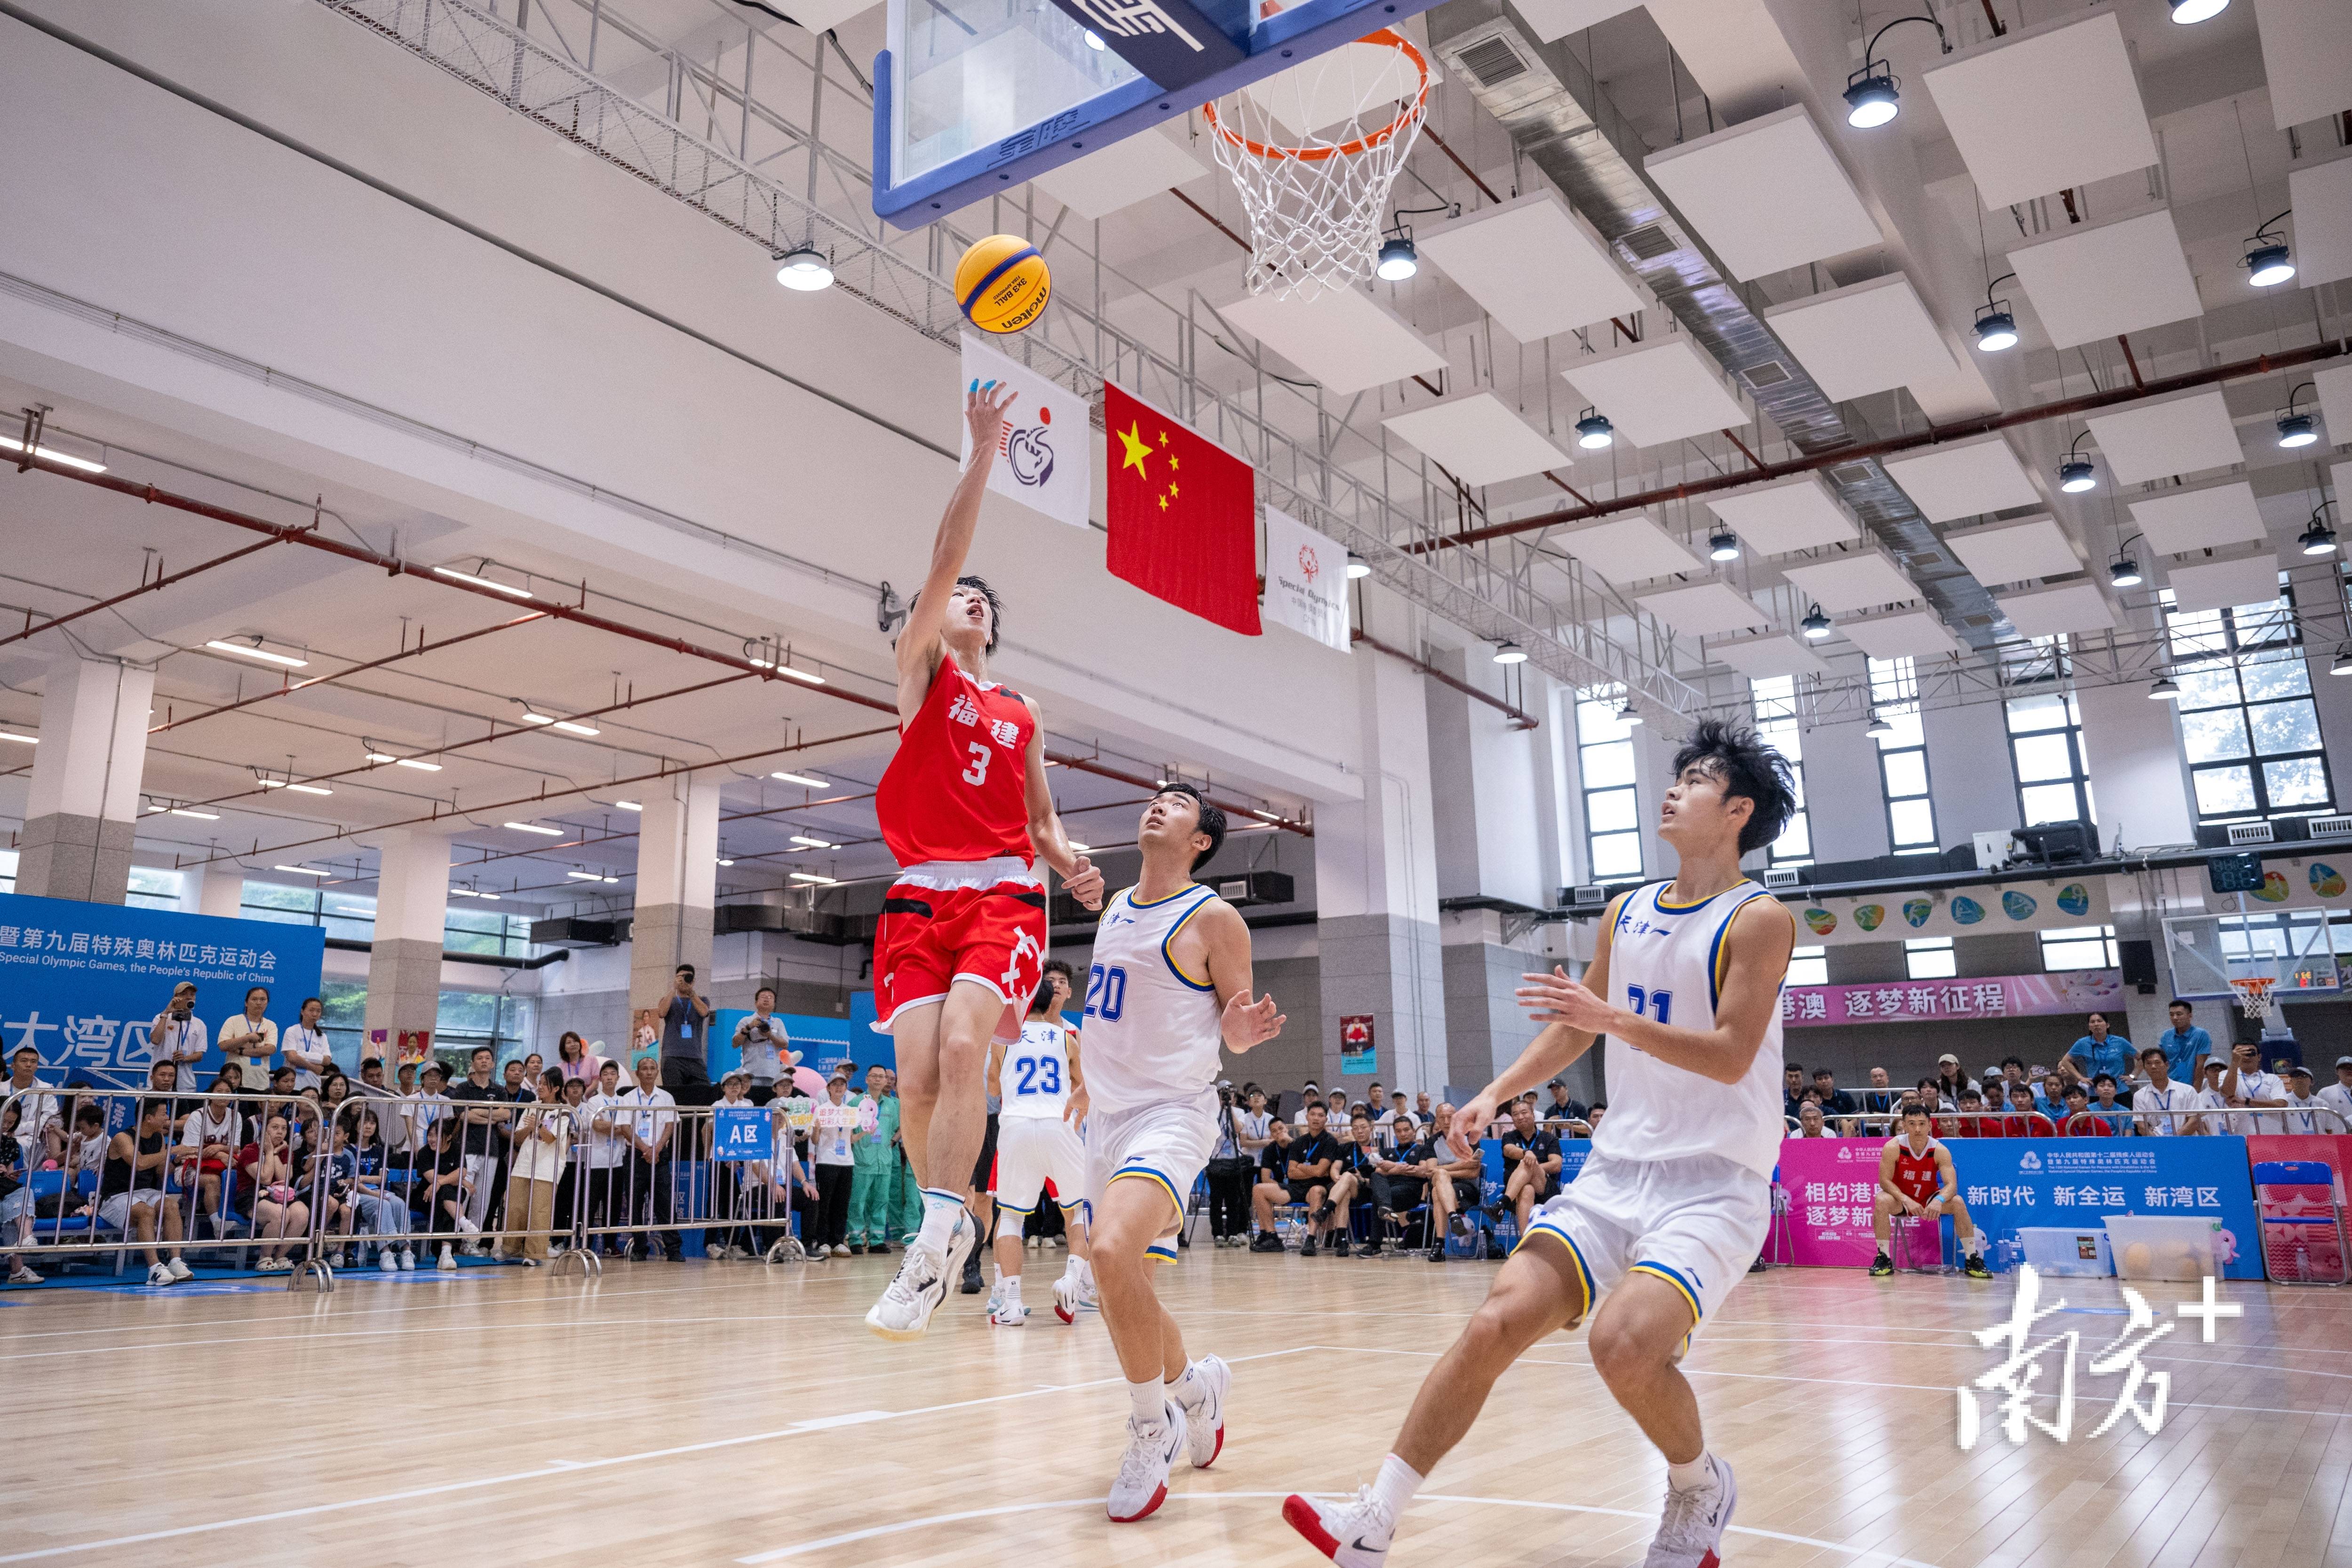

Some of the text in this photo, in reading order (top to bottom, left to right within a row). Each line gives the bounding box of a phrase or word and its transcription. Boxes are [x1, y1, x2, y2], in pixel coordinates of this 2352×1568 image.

[993, 275, 1020, 300] FIBA APPROVED
[994, 290, 1014, 306] BALL
[1001, 286, 1047, 328] molten
[1278, 576, 1304, 595] Special
[948, 694, 1019, 749] 福建
[962, 741, 992, 786] 3
[1618, 915, 1650, 938] 天津
[0, 925, 277, 970] 暨第九届特殊奥林匹克运动会
[0, 951, 274, 984] Special Olympic Games, the People's Republic of China
[1083, 963, 1128, 1023] 20
[1844, 983, 2006, 1018] 逐梦新征程
[2, 1011, 153, 1067] 大湾区
[1015, 1054, 1062, 1096] 23
[730, 1125, 757, 1143] A区
[1913, 1184, 1922, 1197] 7
[1967, 1185, 2221, 1207] 新时代 新全运 新湾区
